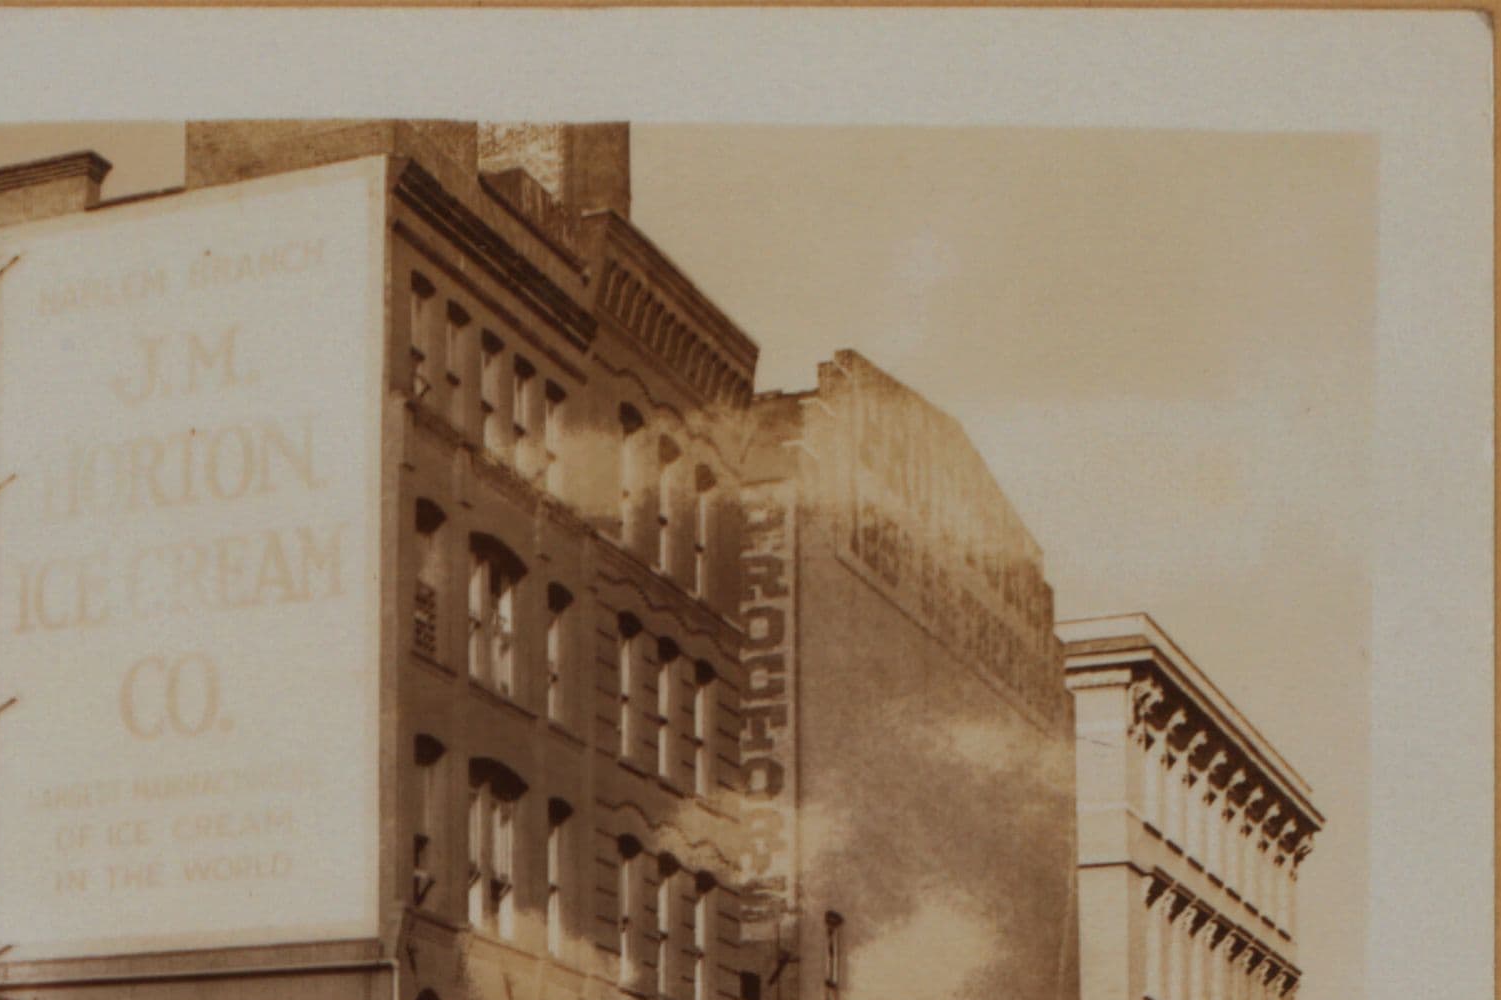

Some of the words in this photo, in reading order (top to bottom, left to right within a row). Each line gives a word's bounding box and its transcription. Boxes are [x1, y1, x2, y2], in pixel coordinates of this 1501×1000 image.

[187, 238, 325, 291] BRANCH
[43, 411, 331, 521] HORTON
[13, 559, 111, 635] ICE
[129, 523, 350, 620] CREAM
[118, 655, 236, 741] CO.
[53, 823, 92, 851] OF
[106, 817, 151, 848] ICE
[170, 807, 297, 840] CREAM
[52, 868, 88, 895] IN
[106, 862, 164, 891] THE
[179, 850, 294, 883] WORLD
